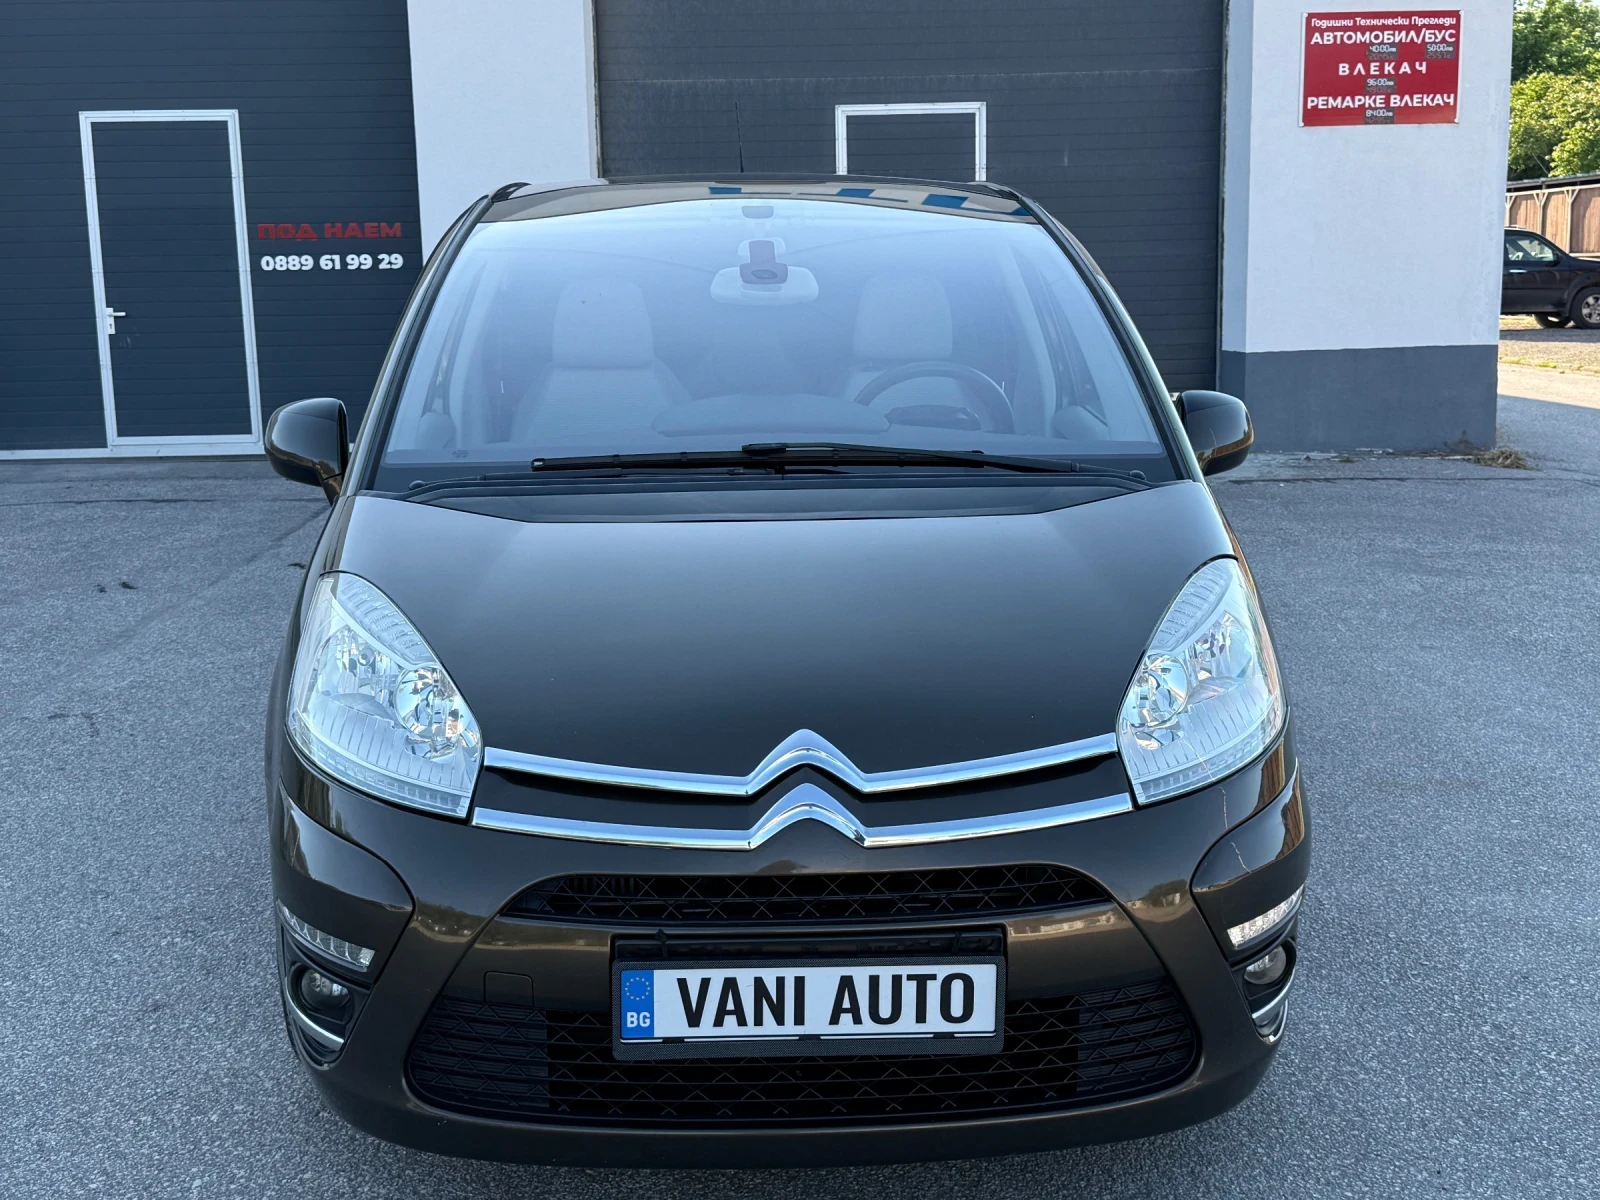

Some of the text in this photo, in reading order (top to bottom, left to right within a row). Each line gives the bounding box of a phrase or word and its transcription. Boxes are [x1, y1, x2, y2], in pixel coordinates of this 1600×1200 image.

[1311, 16, 1456, 28] Годишни Технически Прегледи
[1310, 28, 1456, 44] АВТОМОБИЛ/БУС
[1338, 62, 1426, 76] ВЛЕКАЧ
[1307, 94, 1454, 109] РЕМАРКЕ ВЛЕКАЧ
[257, 222, 402, 242] ПОД НАЕМ
[260, 254, 404, 271] 0889 61 99 29
[676, 972, 974, 1028] VANI AUTO
[626, 1012, 650, 1028] BG
